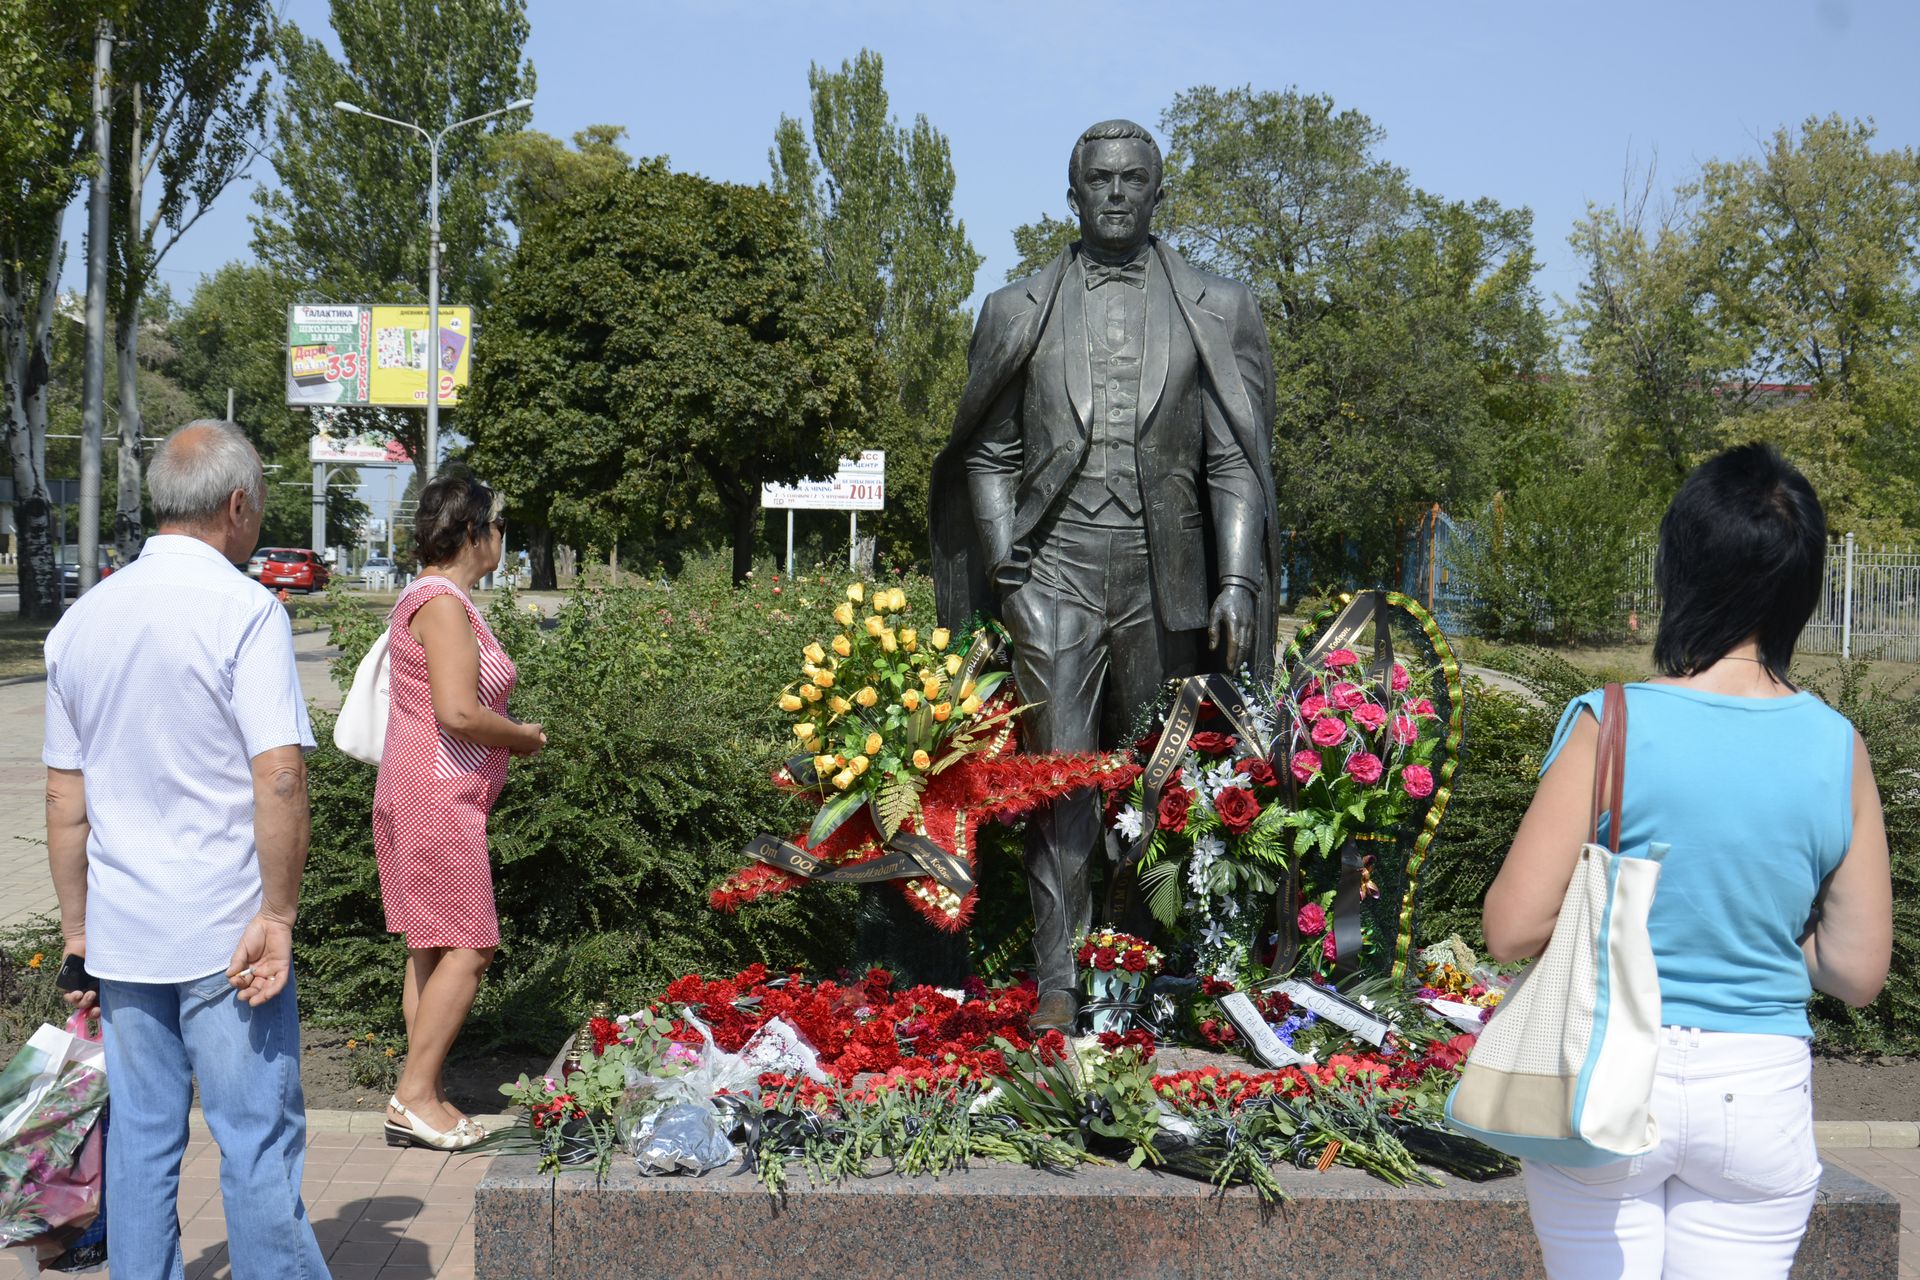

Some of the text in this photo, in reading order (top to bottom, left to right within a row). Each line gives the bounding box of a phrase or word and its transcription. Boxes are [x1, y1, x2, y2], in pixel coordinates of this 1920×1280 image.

[304, 309, 353, 317] ГАЛАКТИКА
[299, 324, 353, 334] ШКОЛЬНЫЙ
[311, 334, 340, 342] БАЗАР
[325, 353, 357, 381] 33
[850, 484, 882, 500] 2014
[1148, 703, 1193, 791] КОБЗОНУ
[759, 843, 778, 860] От
[789, 854, 822, 875] ООО
[1304, 995, 1378, 1038] КОБЗОНУ
